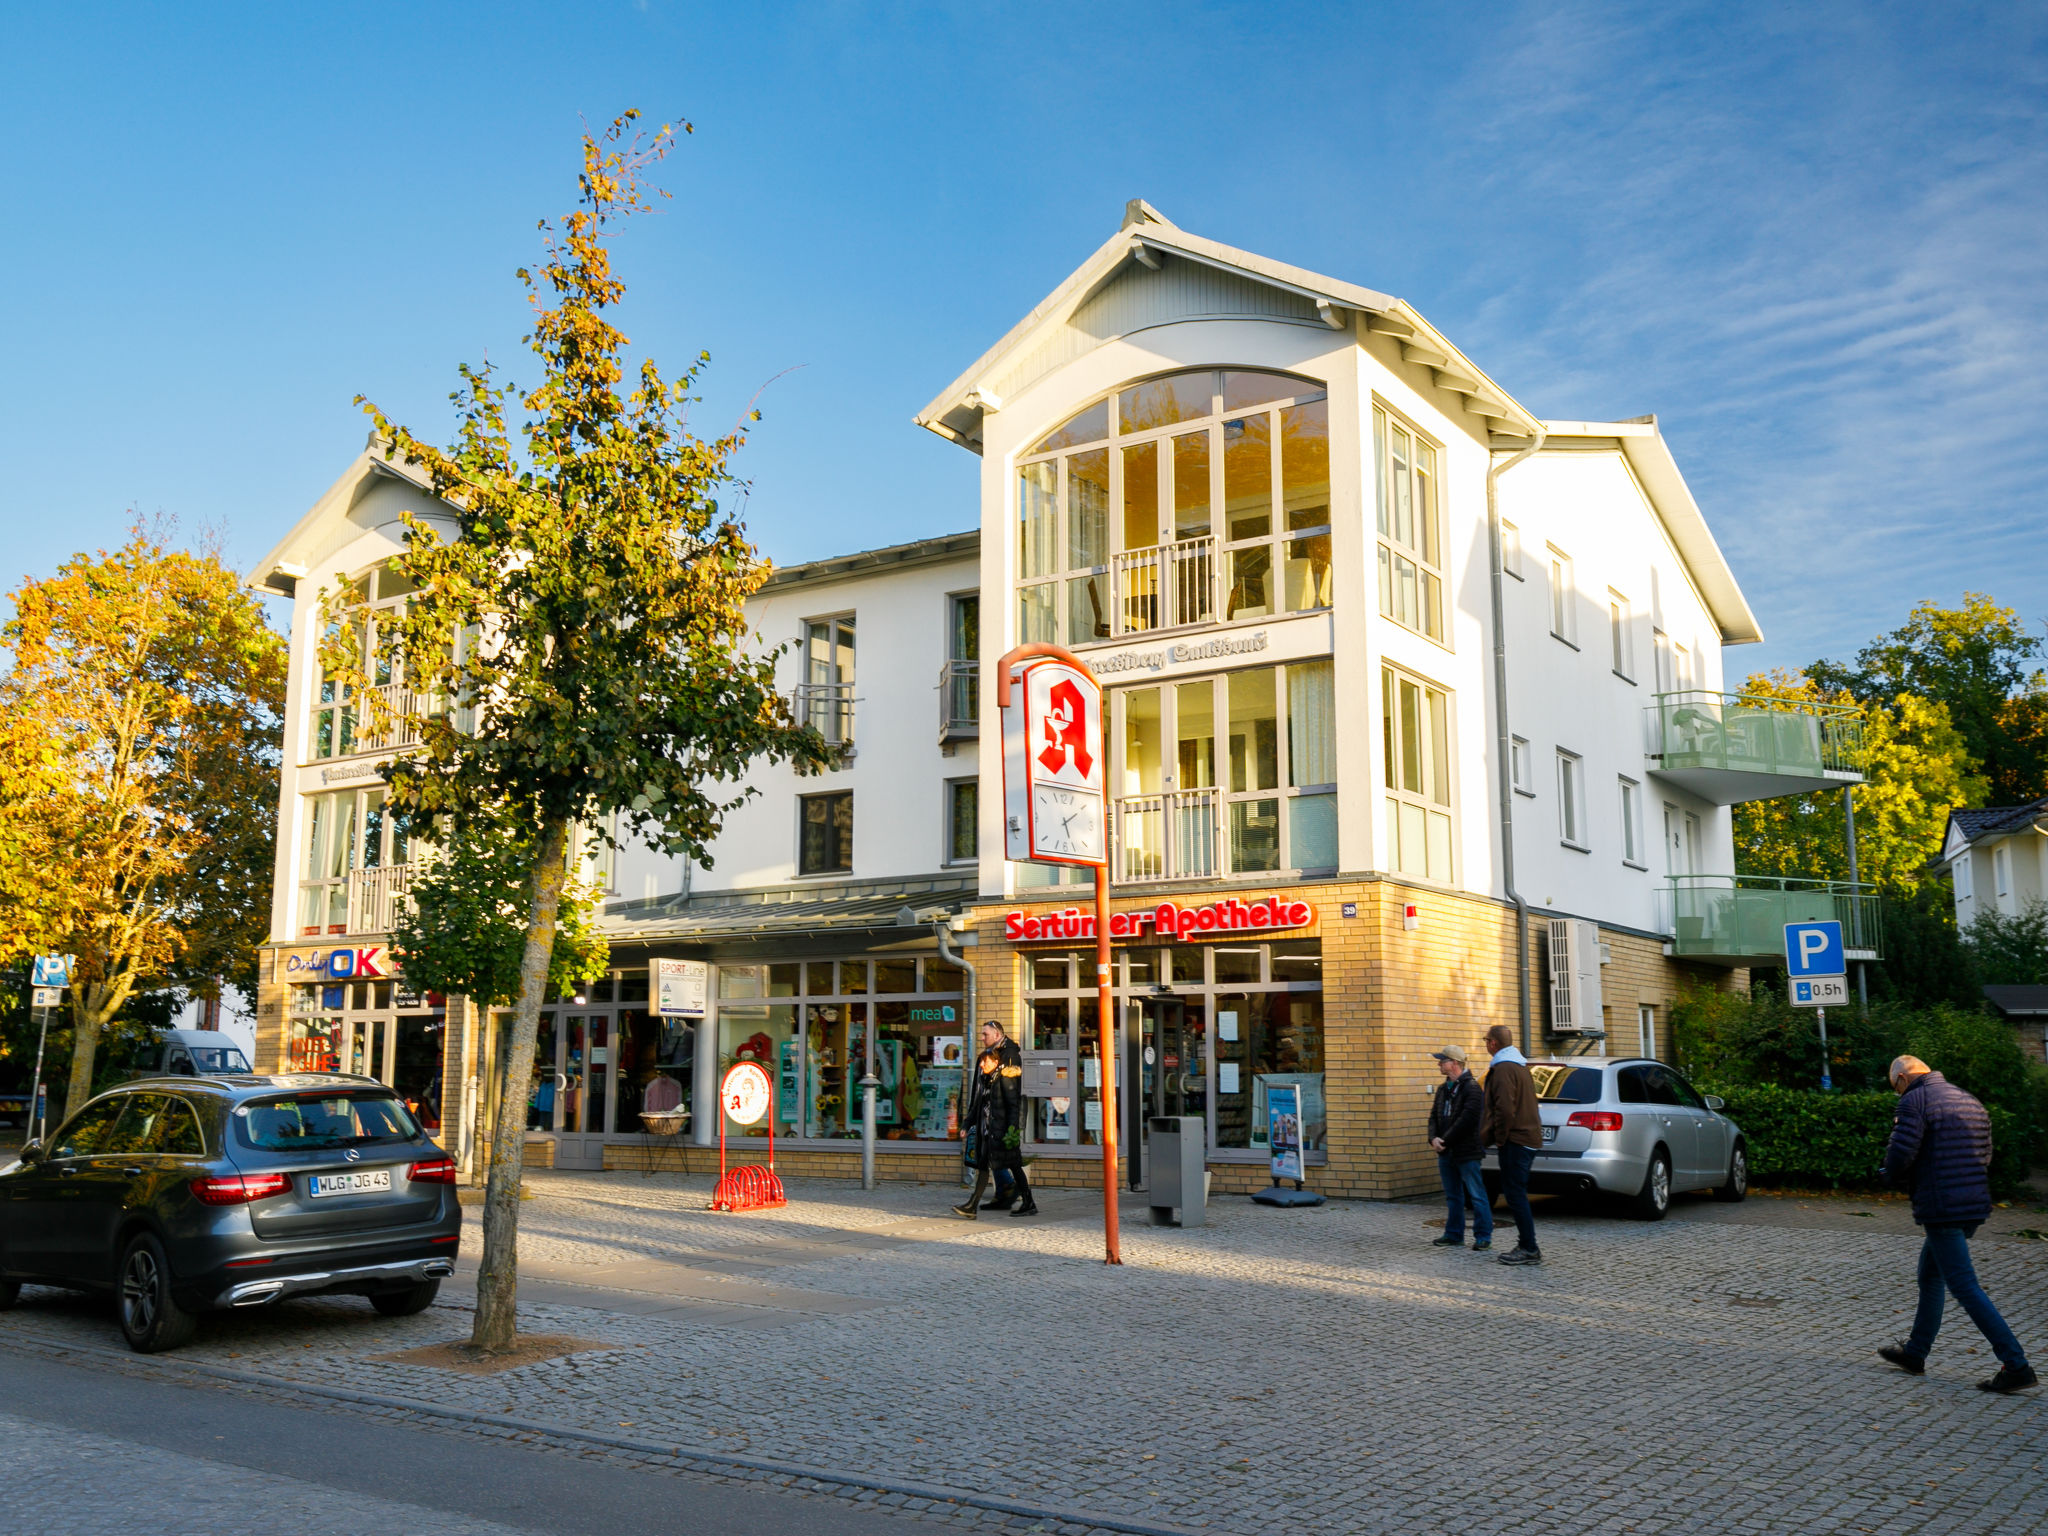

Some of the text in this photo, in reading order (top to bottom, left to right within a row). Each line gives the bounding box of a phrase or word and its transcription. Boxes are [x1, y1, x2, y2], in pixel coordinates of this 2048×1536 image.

[1006, 896, 1311, 940] Sertürer-Apotheke
[1344, 906, 1355, 914] 39
[1798, 929, 1829, 969] P
[287, 948, 383, 979] Only OK
[1812, 984, 1842, 996] 0.5h
[911, 1009, 941, 1020] mea
[320, 1172, 389, 1191] WLG JG 43
